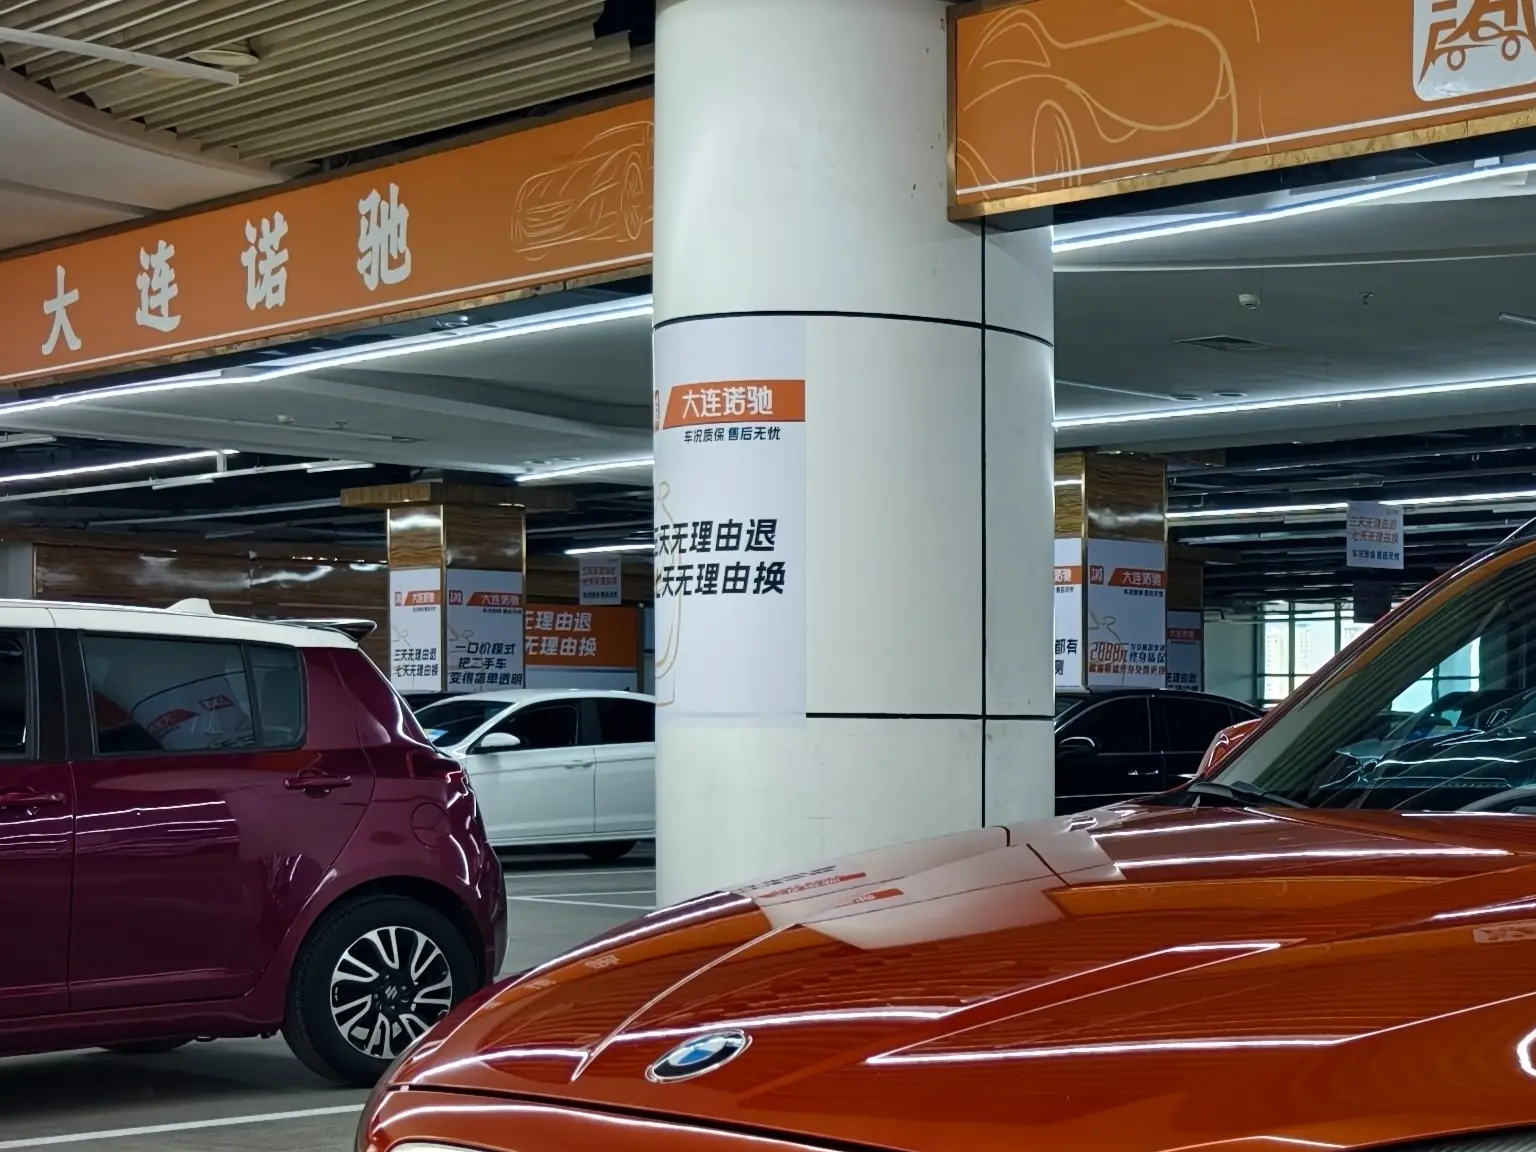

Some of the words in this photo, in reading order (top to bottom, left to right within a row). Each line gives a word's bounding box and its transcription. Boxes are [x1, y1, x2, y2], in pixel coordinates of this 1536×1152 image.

[41, 183, 412, 355] 大连诺驰
[682, 386, 773, 420] 大连诺驰
[684, 428, 725, 443] 车况质保
[727, 426, 781, 442] 售后无忧
